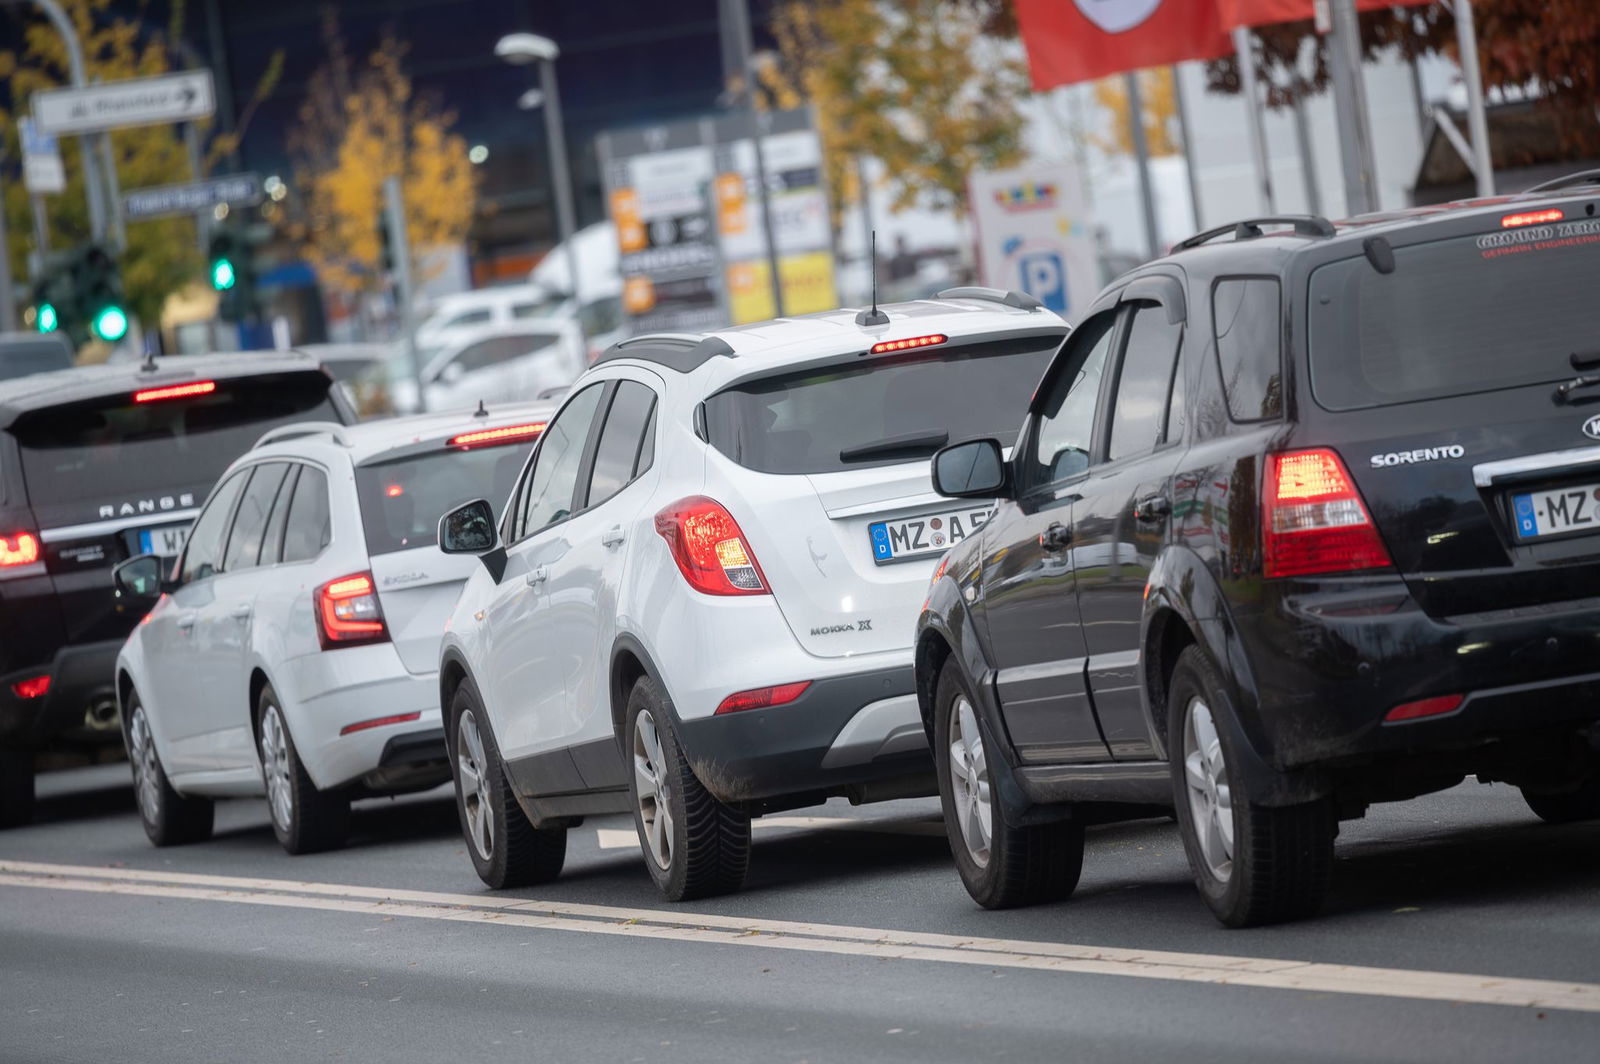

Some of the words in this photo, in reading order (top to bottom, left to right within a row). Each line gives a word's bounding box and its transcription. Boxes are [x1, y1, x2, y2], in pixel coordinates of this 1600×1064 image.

[1476, 226, 1553, 249] GROUND
[1370, 444, 1465, 469] SORENTO
[99, 493, 194, 518] RANGE
[1545, 490, 1593, 529] MZ
[810, 623, 855, 636] MOKKA
